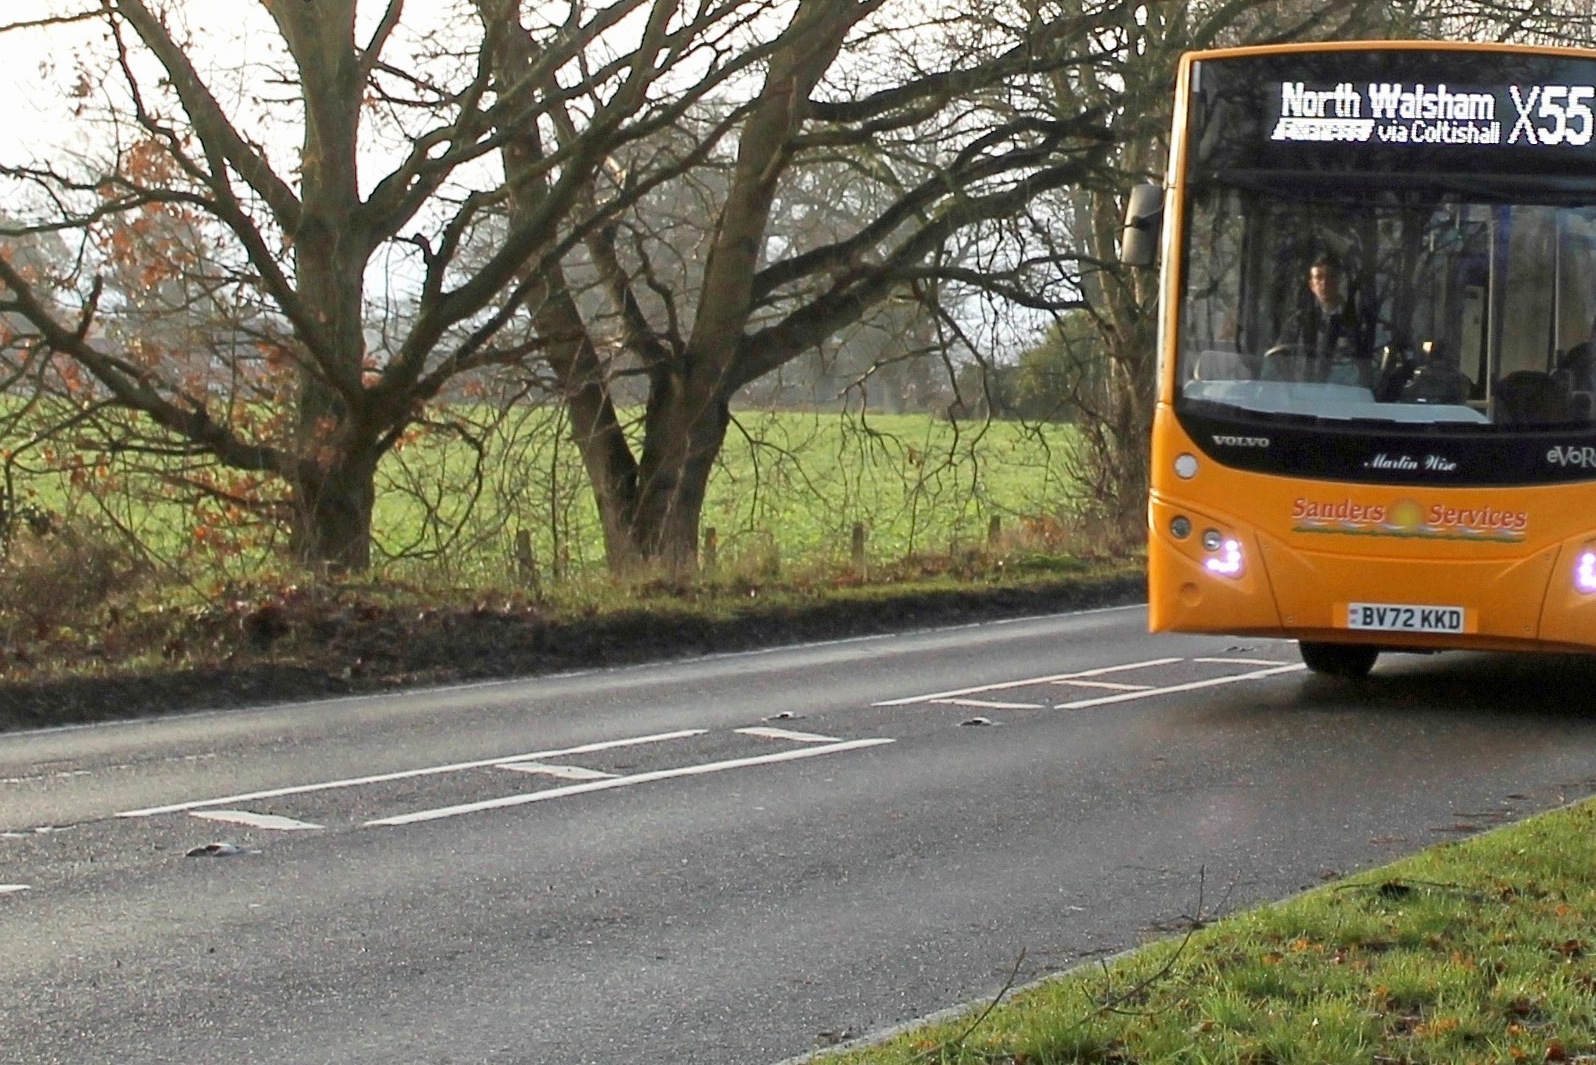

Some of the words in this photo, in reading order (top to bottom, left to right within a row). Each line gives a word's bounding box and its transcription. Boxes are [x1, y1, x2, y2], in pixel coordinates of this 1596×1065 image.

[1281, 82, 1361, 117] North
[1368, 83, 1495, 120] Walsham
[1507, 85, 1596, 146] X55
[1377, 120, 1408, 142] via
[1411, 120, 1500, 144] Coltishall
[1212, 435, 1270, 447] VOLVO
[1292, 498, 1386, 523] Sanders
[1428, 504, 1528, 530] Services
[1362, 607, 1415, 627] BV72
[1421, 609, 1461, 629] KKD
